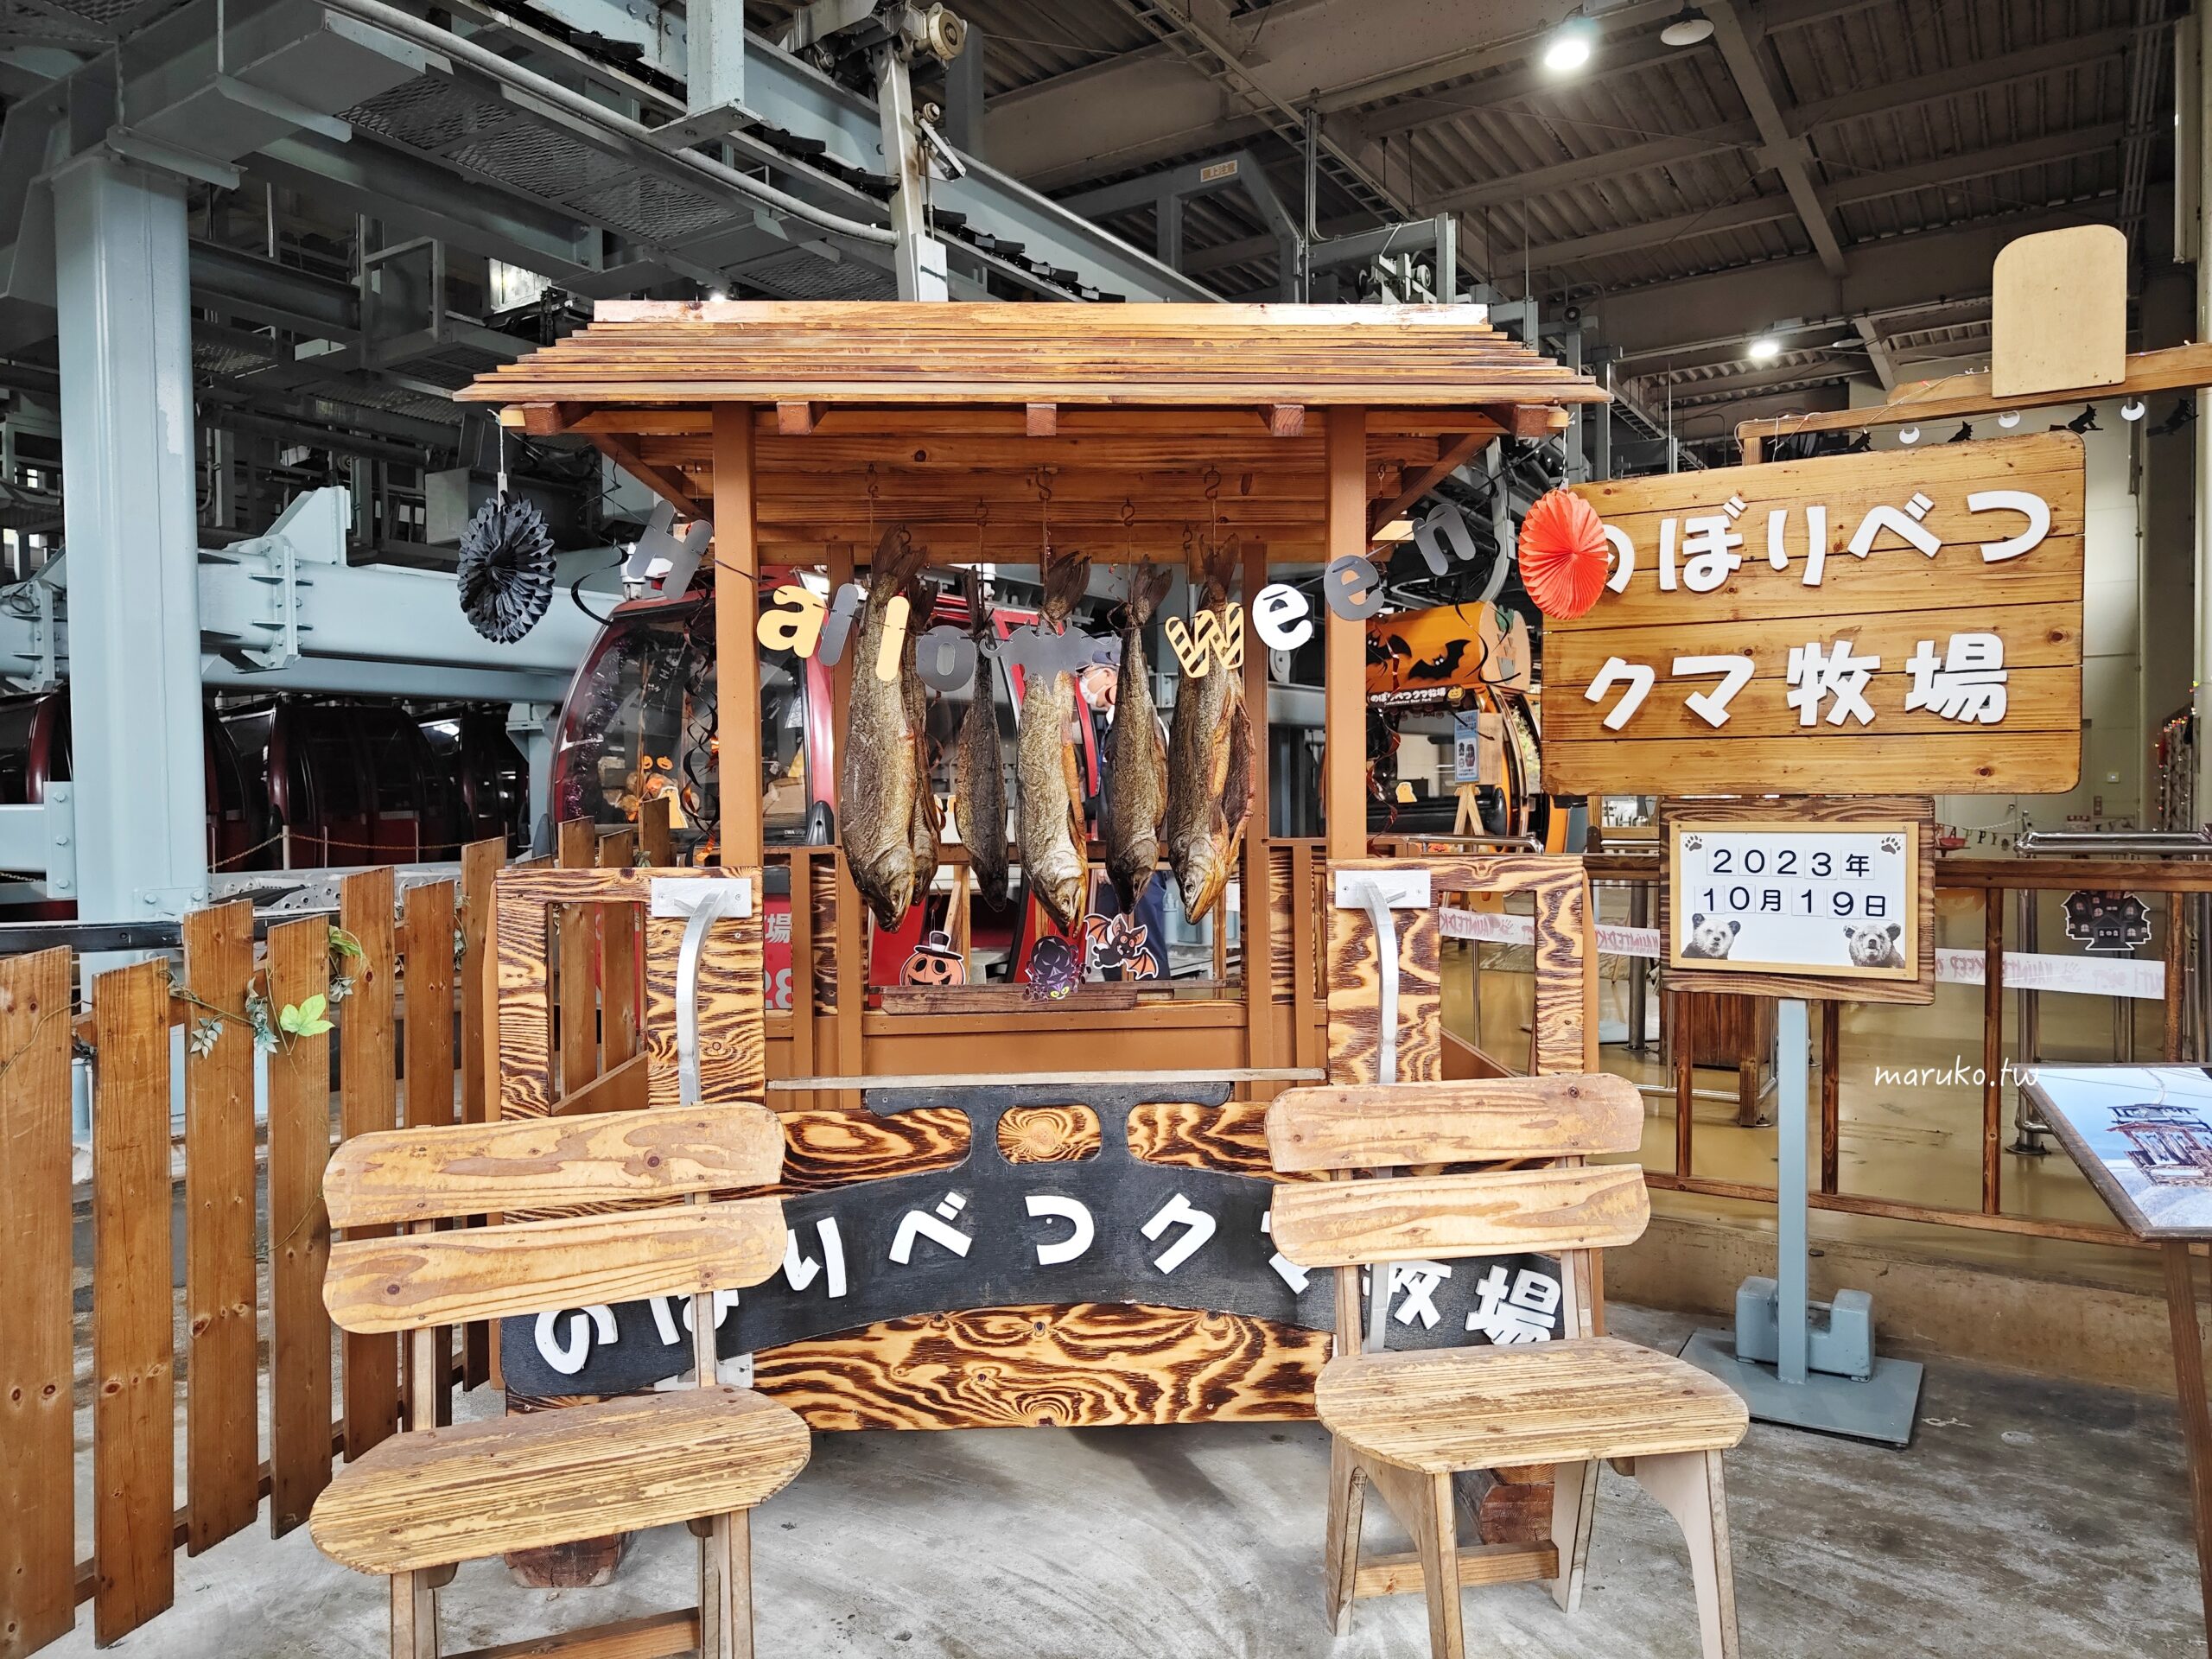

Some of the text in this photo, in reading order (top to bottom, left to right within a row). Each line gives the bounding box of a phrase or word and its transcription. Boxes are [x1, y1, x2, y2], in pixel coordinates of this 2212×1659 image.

[1584, 632, 2008, 731] クマ牧場
[1713, 849, 1871, 878] 2023年
[1702, 886, 1886, 918] 10月19日
